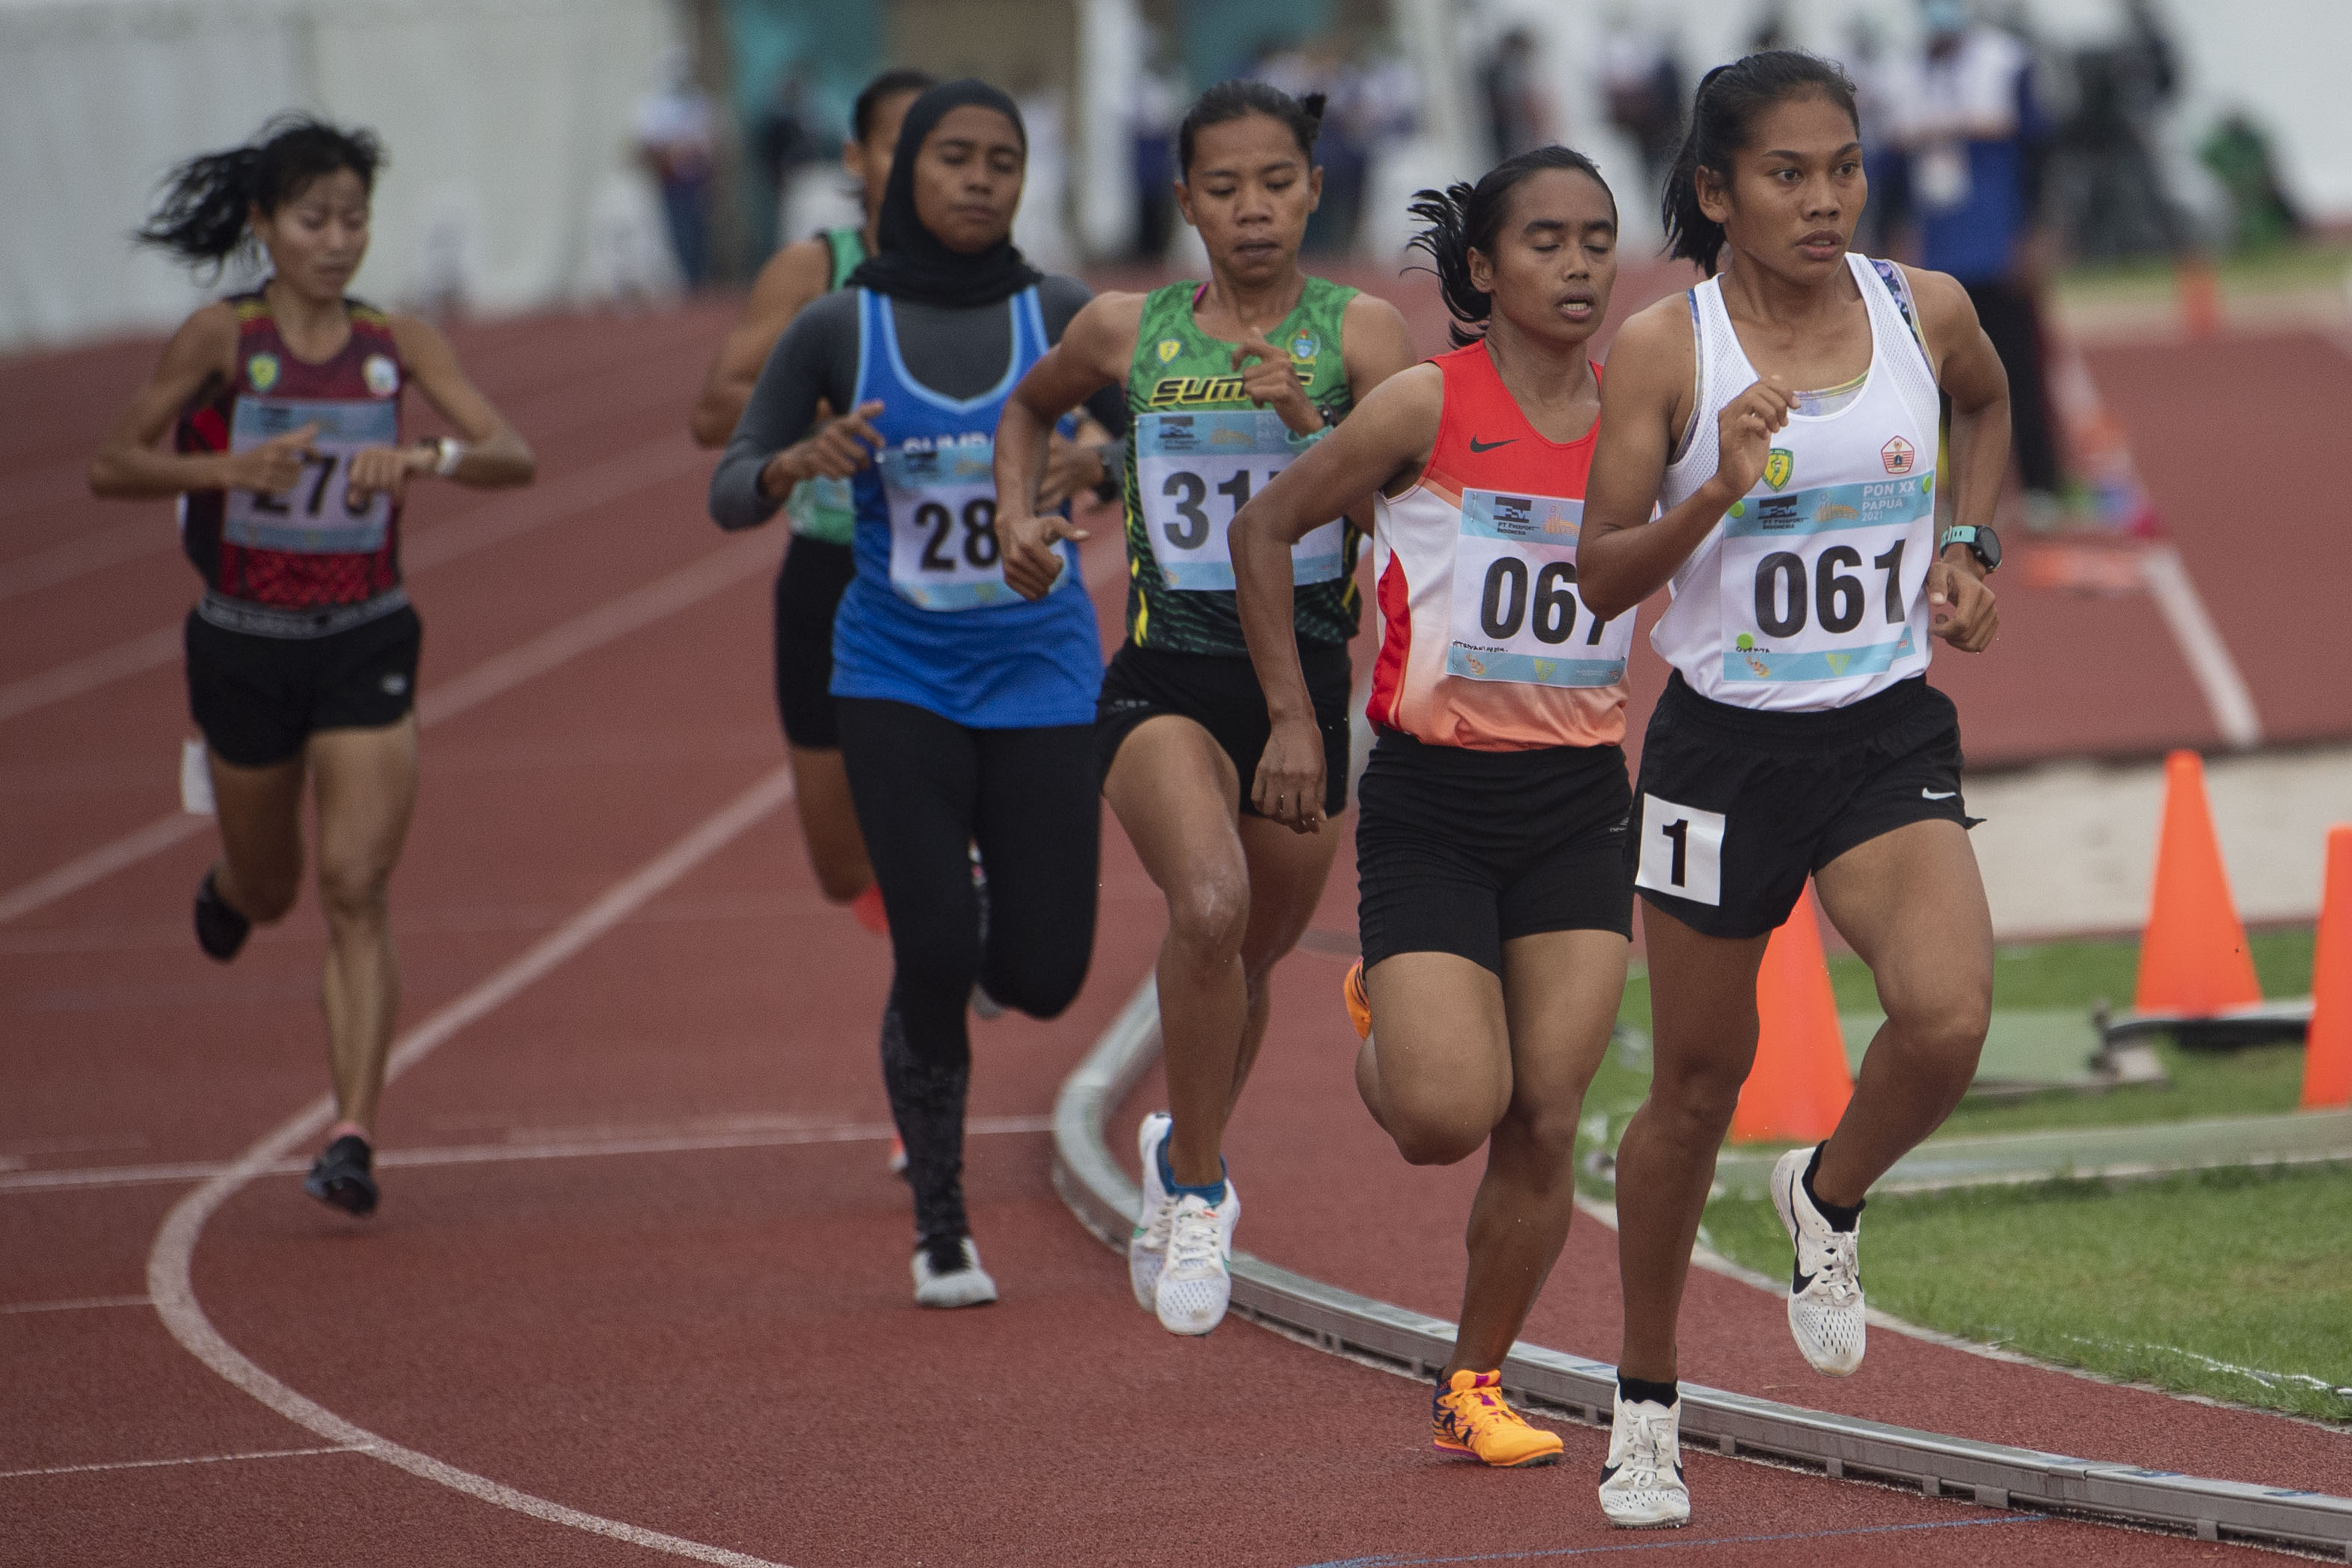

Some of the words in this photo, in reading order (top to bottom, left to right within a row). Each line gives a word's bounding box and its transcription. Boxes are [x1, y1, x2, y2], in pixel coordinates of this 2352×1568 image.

[1149, 372, 1315, 407] SUM
[1162, 469, 1283, 552] 31
[1861, 498, 1903, 512] PAPUA
[1863, 484, 1894, 496] PON
[1898, 480, 1916, 494] XX
[914, 498, 1003, 573] 28
[1861, 510, 1883, 523] 2021
[1754, 538, 1906, 638] 061
[1662, 819, 1688, 887] 1
